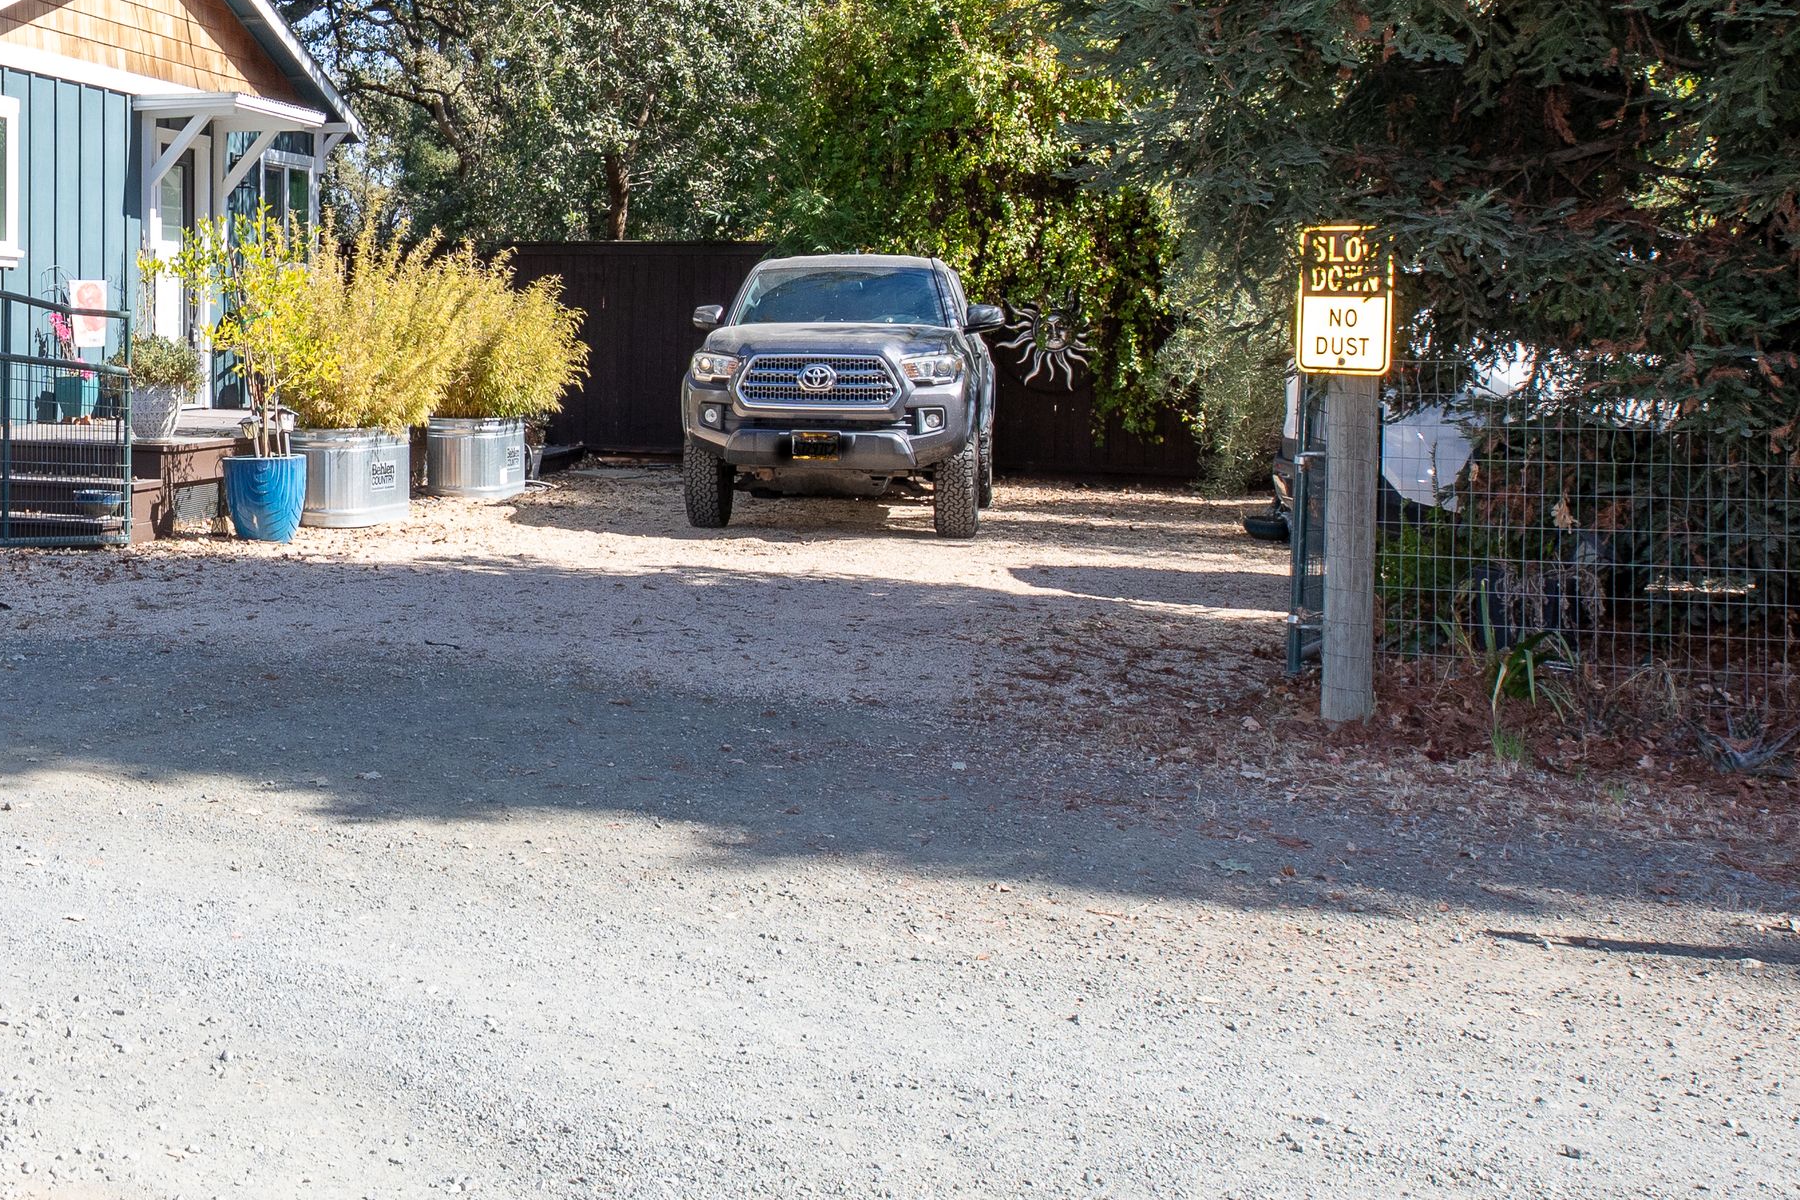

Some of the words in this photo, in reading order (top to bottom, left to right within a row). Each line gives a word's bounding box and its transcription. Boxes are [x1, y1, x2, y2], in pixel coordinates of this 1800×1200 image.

[1329, 308, 1358, 328] NO
[1316, 336, 1370, 357] DUST
[371, 462, 395, 476] Behlen
[371, 474, 395, 486] COUNTRY
